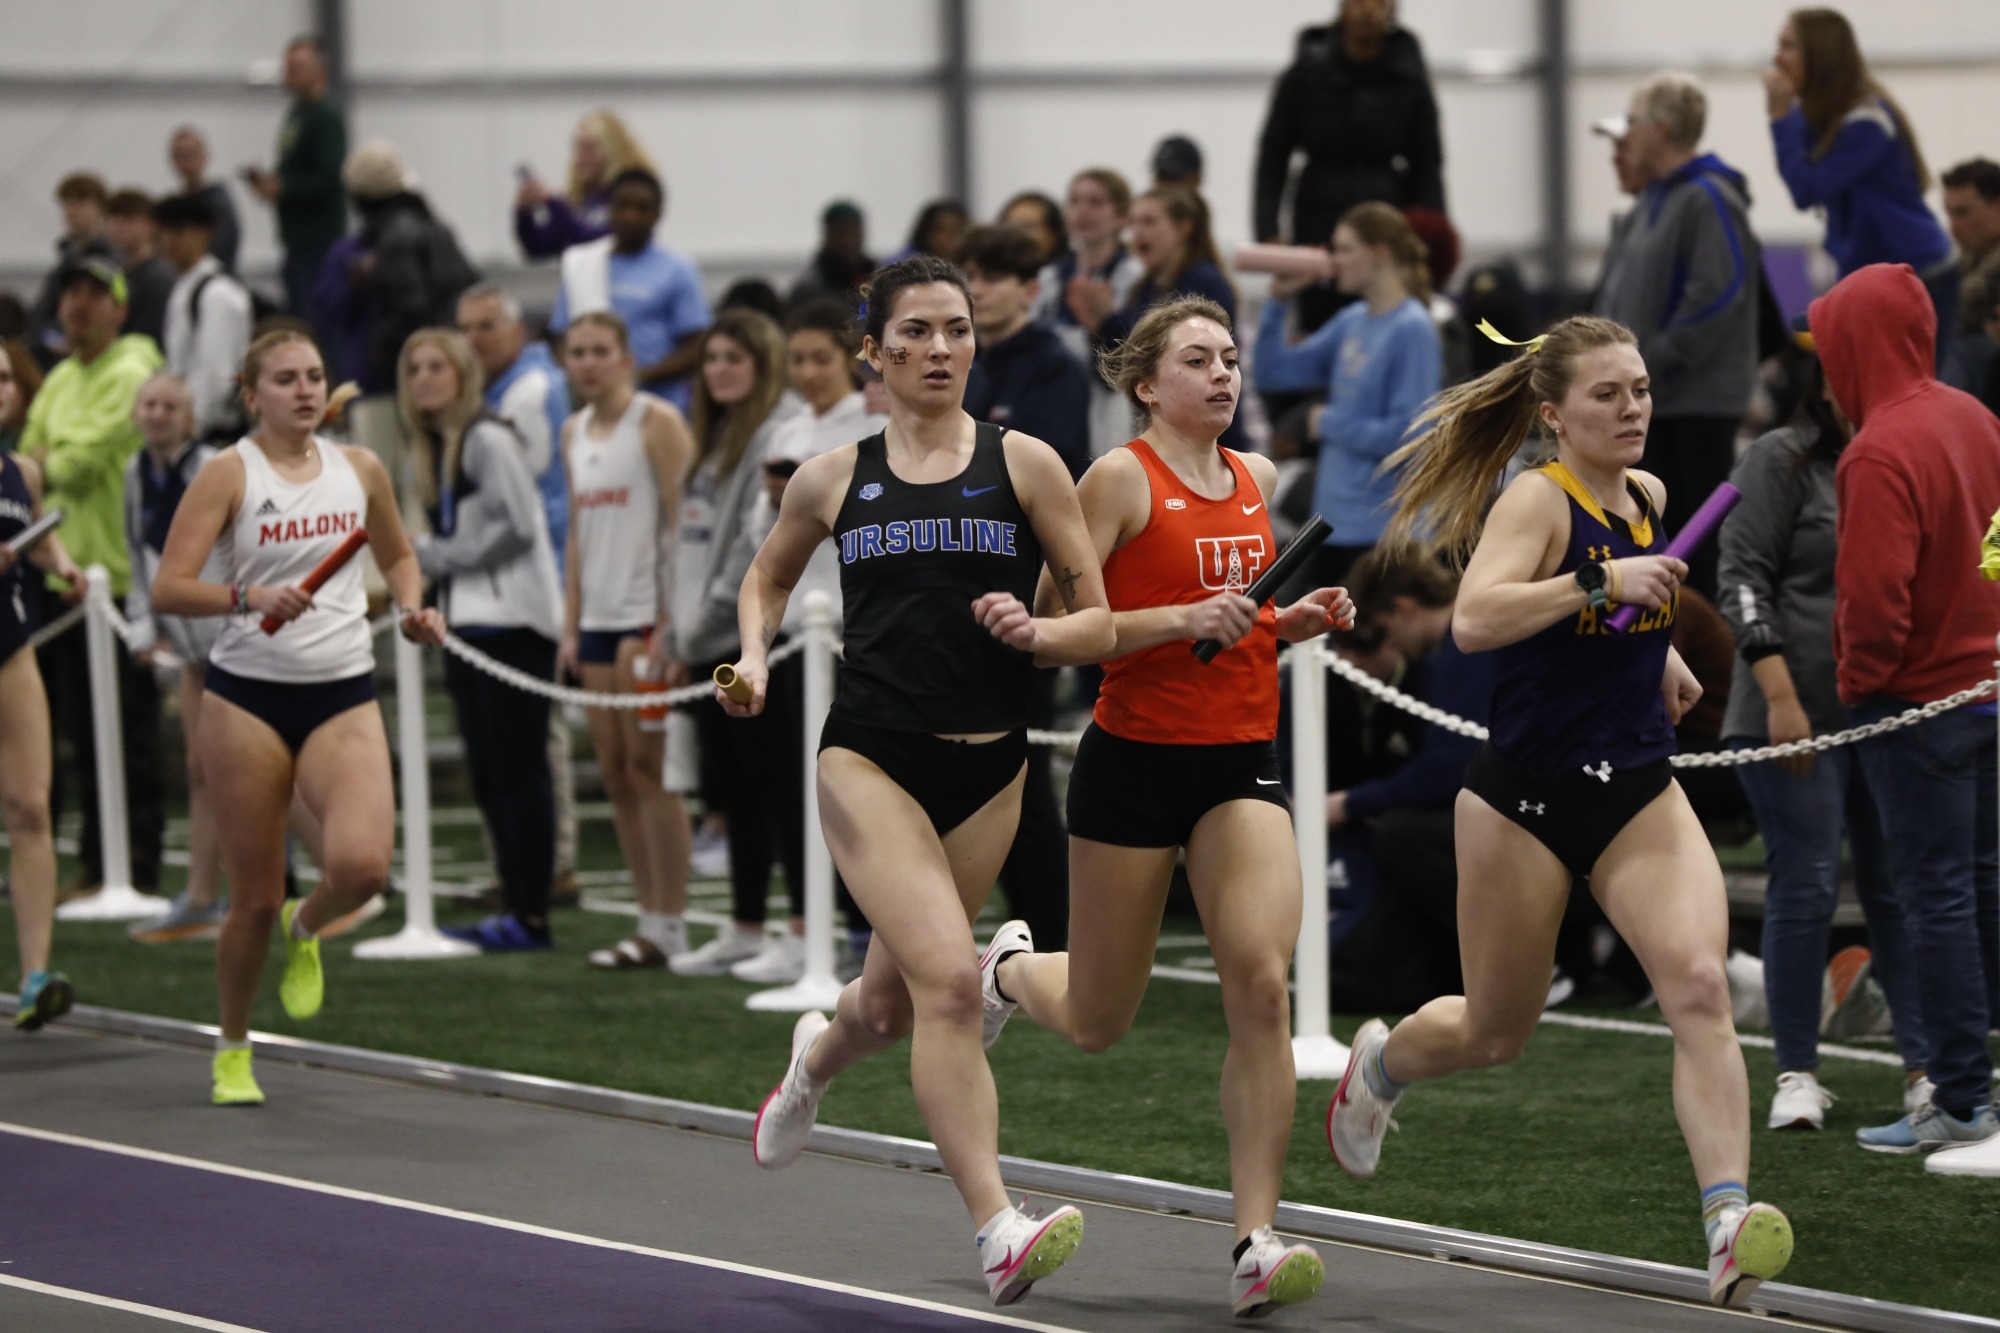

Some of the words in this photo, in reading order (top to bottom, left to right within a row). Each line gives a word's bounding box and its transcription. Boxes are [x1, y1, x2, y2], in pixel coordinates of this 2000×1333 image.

[258, 511, 358, 546] MALONE
[841, 518, 1017, 564] URSULINE
[1195, 534, 1266, 592] UF
